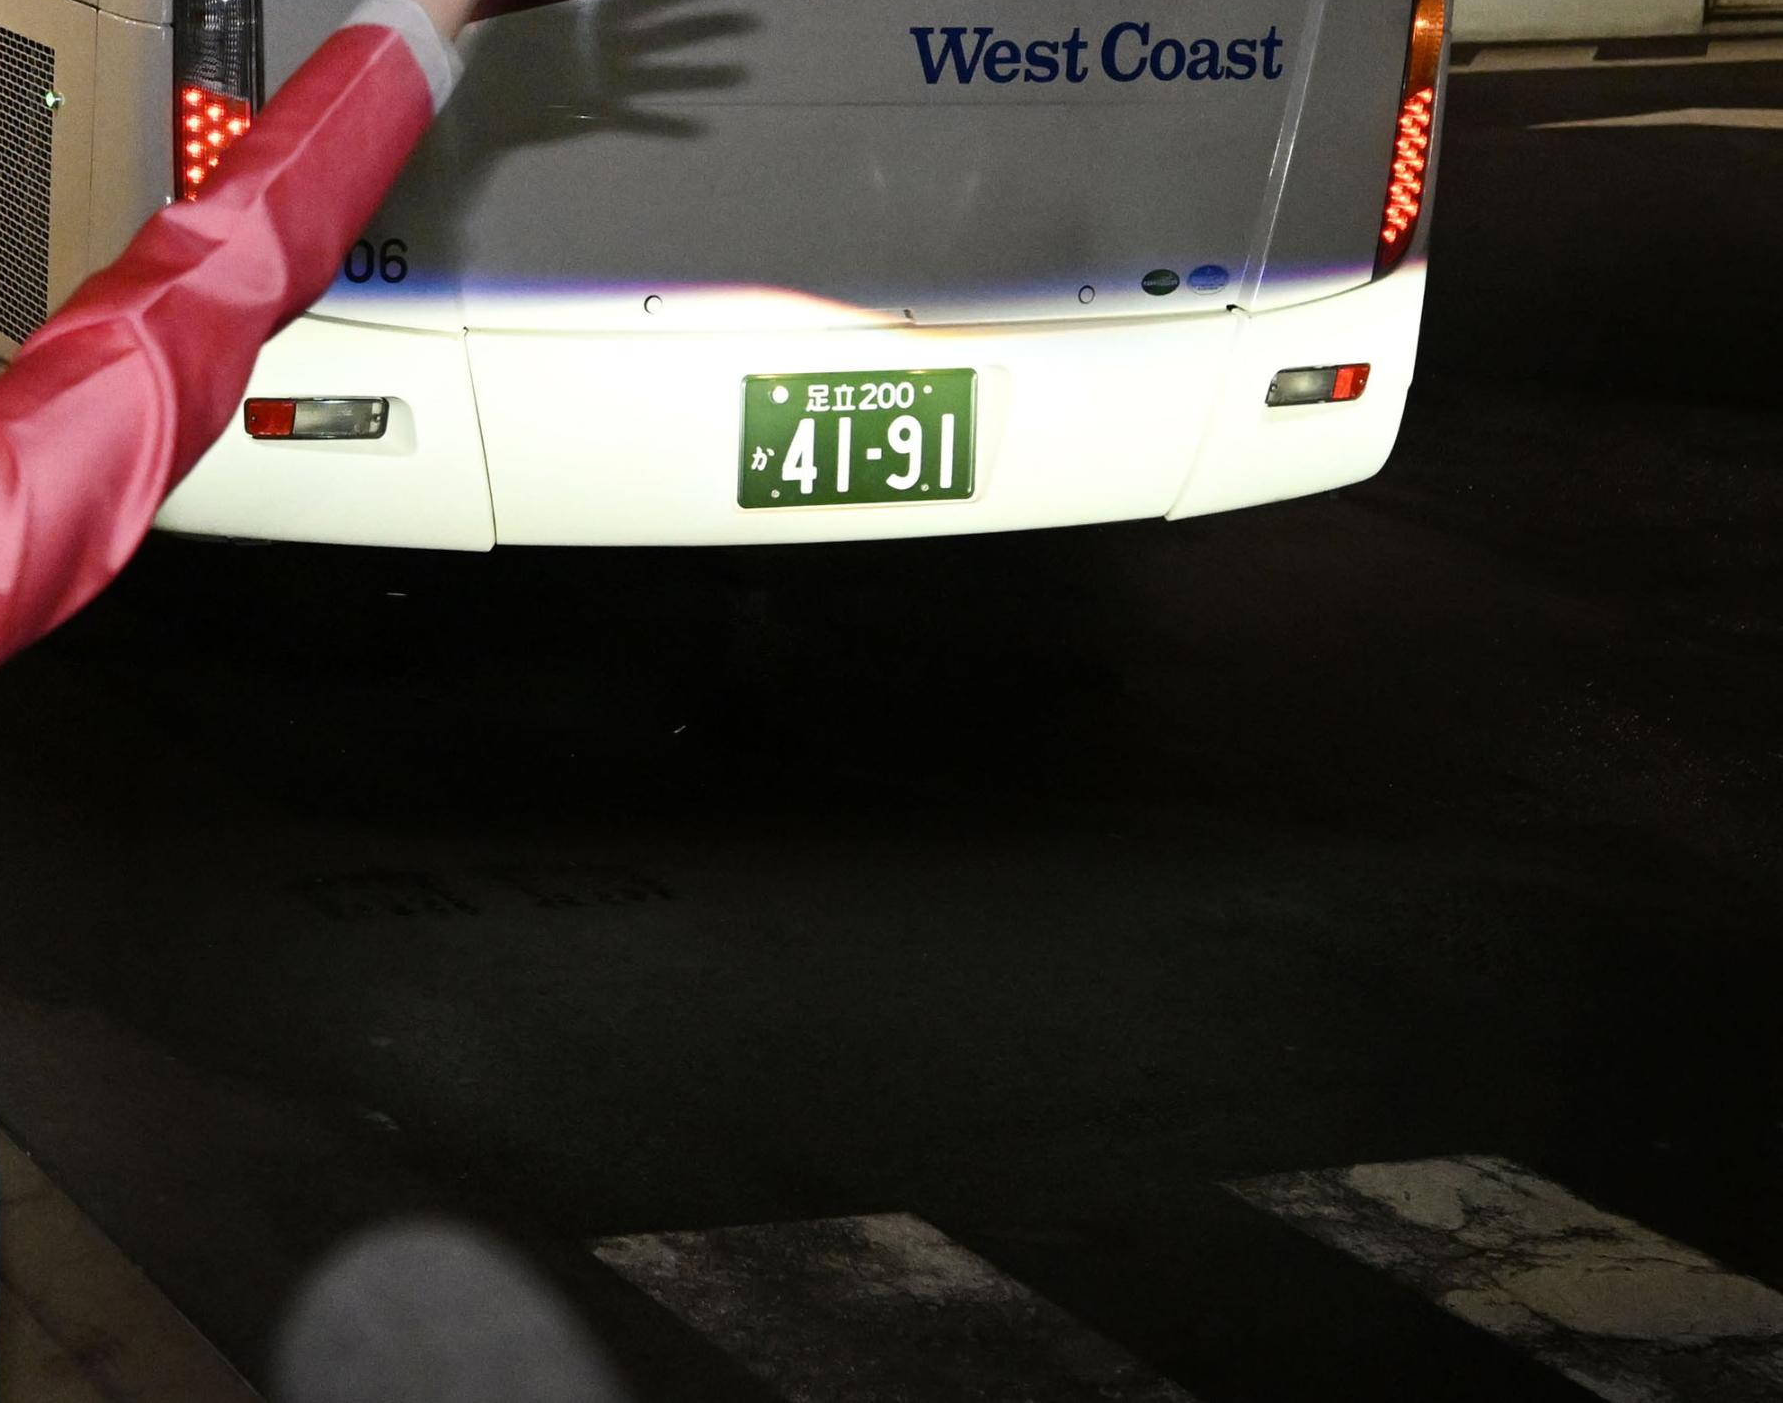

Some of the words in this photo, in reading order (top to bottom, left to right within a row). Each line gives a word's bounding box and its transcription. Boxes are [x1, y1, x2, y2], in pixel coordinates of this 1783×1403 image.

[909, 26, 1089, 85] West
[1101, 21, 1284, 83] Coast
[750, 446, 775, 472] か
[781, 413, 956, 495] 41-91
